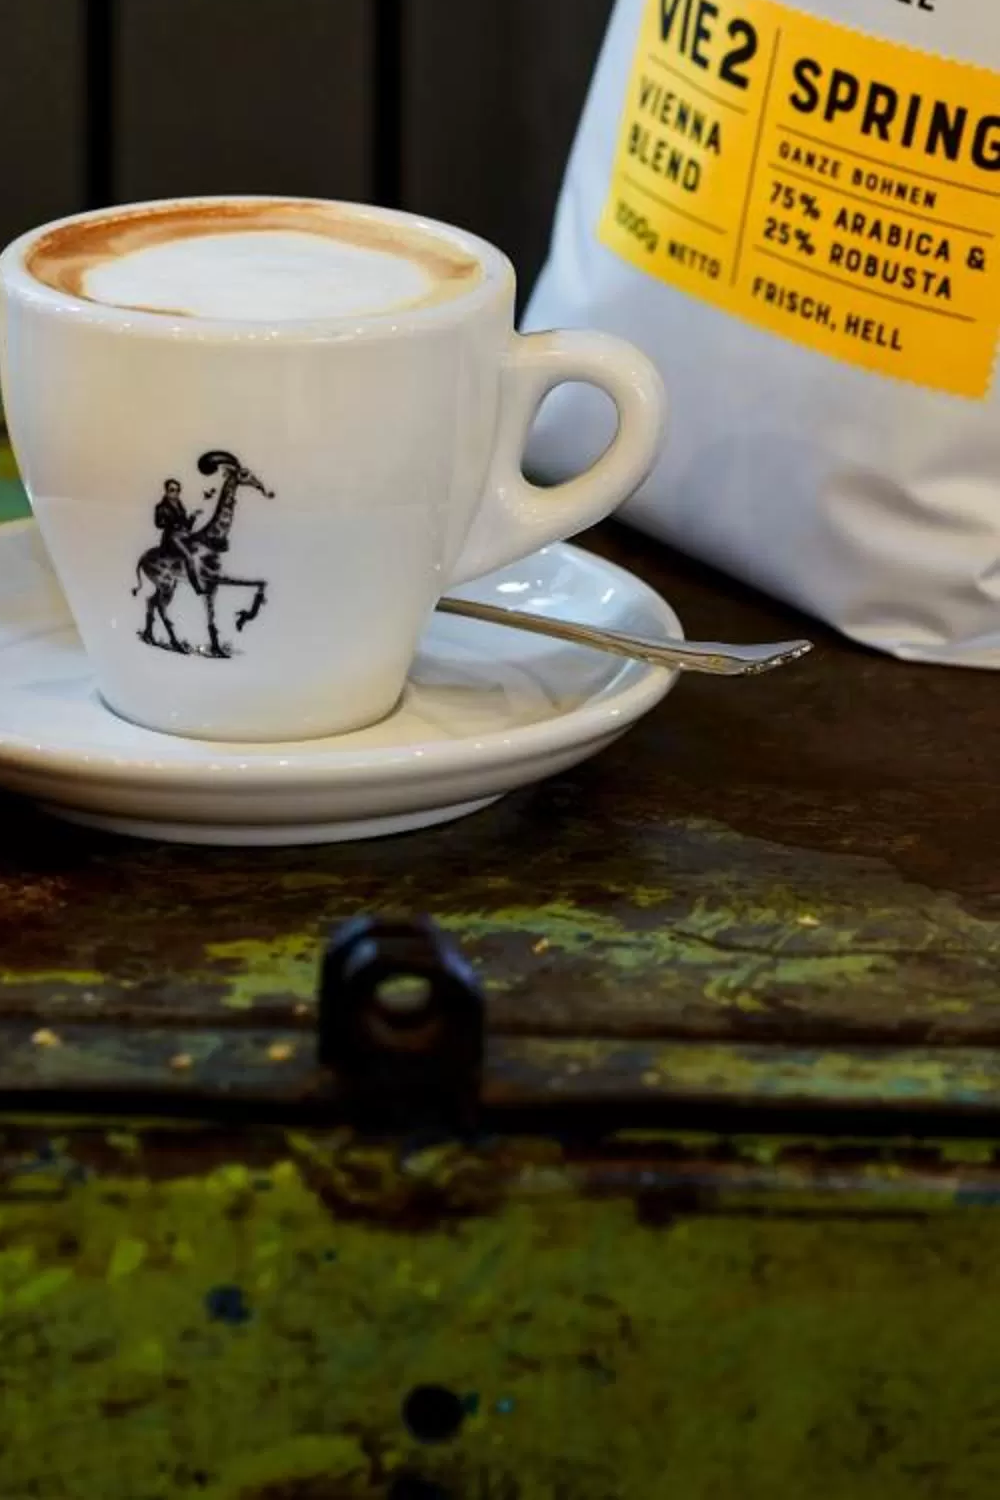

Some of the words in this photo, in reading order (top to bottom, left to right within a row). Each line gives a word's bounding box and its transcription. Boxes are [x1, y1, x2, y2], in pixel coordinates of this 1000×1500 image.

[639, 75, 722, 156] VIENNA
[788, 57, 1000, 172] SPRING
[629, 121, 702, 193] BLEND
[778, 140, 842, 180] GANZE
[852, 167, 938, 210] BOHNEN
[763, 217, 816, 256] 25%
[829, 243, 953, 300] ROBUSTA
[769, 181, 821, 221] 75%
[834, 207, 951, 263] ARABICA
[966, 246, 986, 272] &
[752, 276, 837, 332] FRISCH,
[844, 313, 904, 352] HELL
